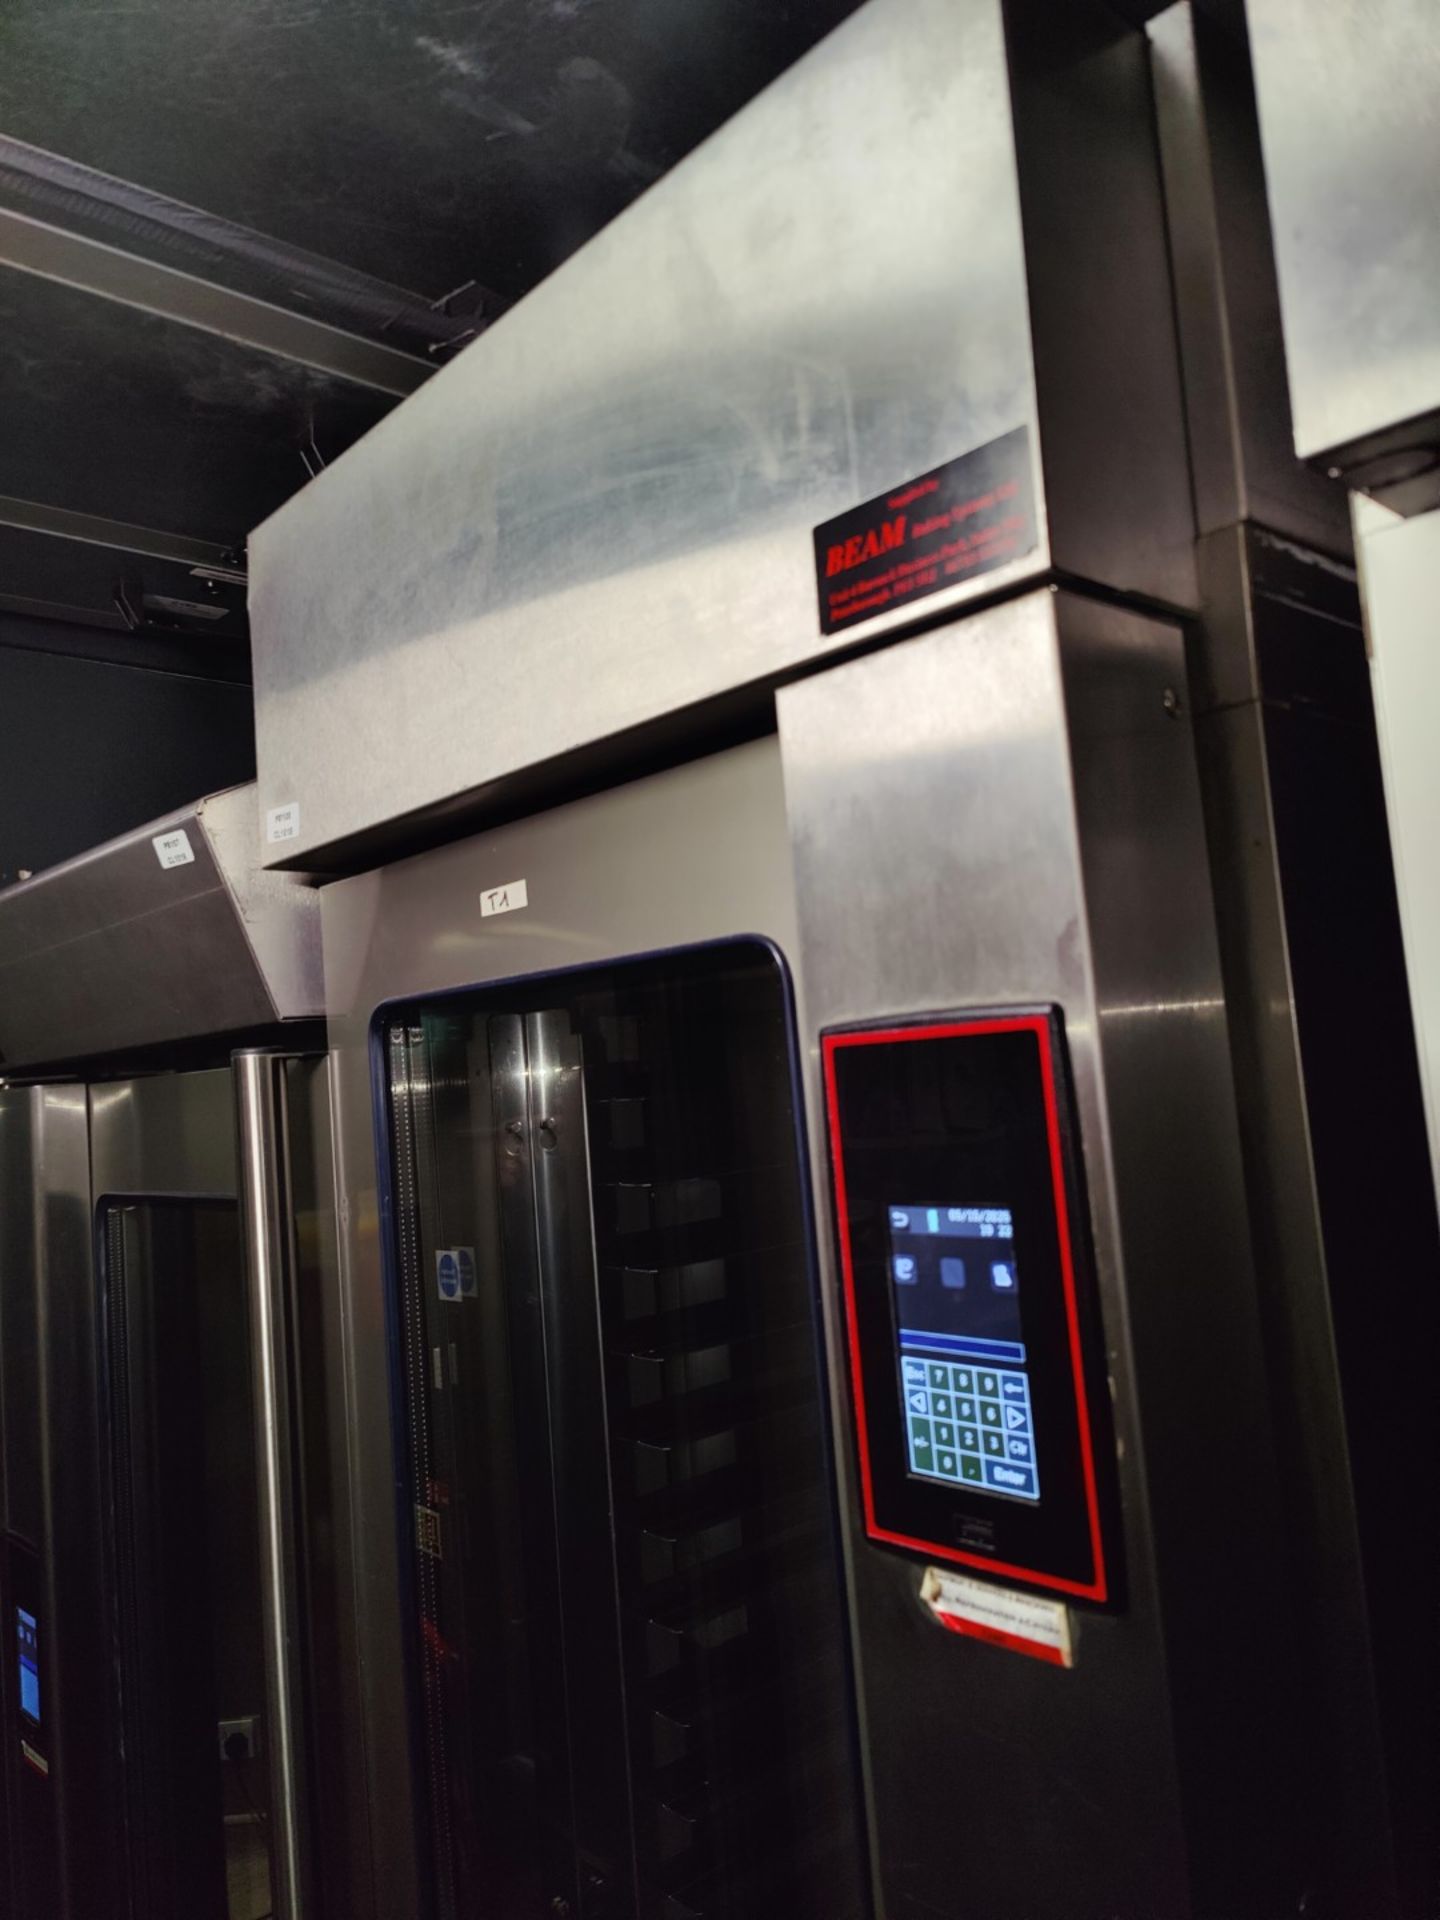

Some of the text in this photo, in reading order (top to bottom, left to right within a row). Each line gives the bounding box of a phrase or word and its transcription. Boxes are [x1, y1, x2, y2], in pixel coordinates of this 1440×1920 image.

[826, 514, 906, 578] BEAM
[487, 890, 509, 911] T1
[934, 1369, 943, 1384] 7
[993, 1466, 1027, 1486] Enter
